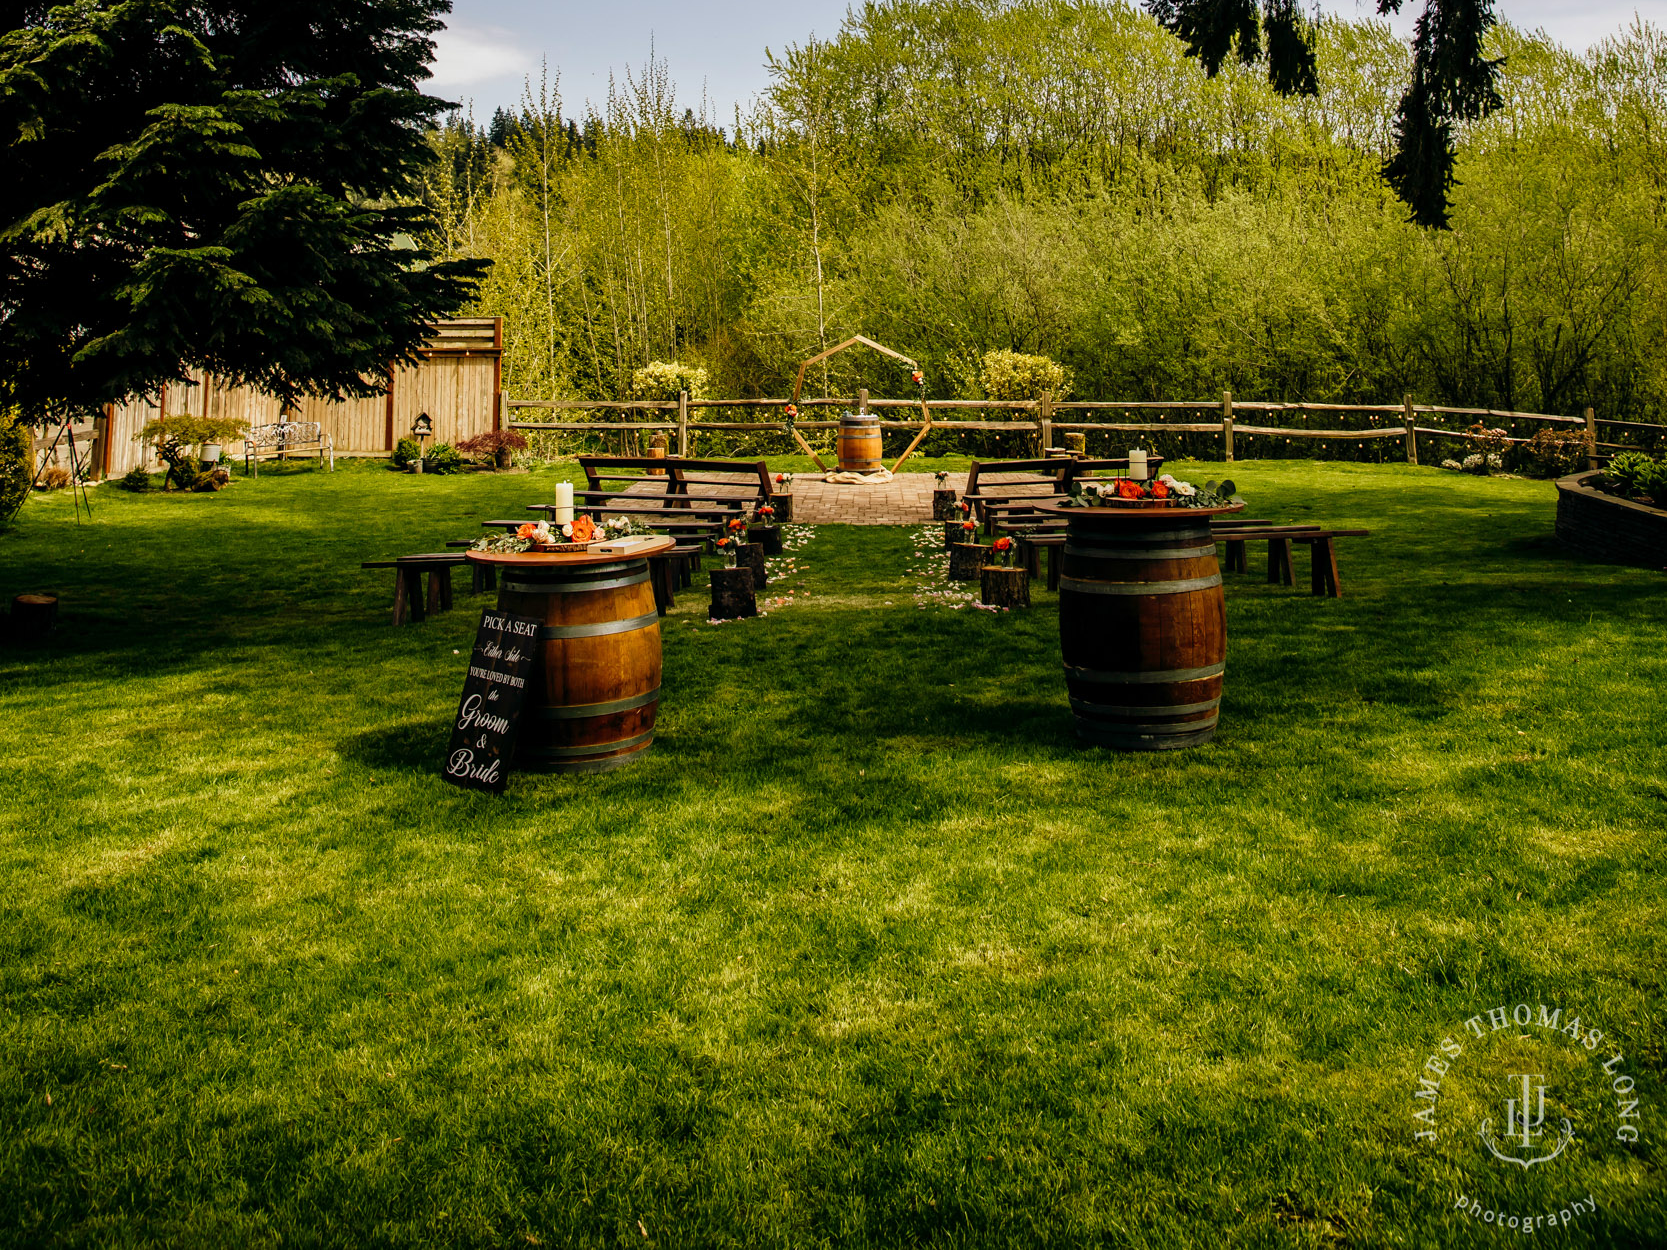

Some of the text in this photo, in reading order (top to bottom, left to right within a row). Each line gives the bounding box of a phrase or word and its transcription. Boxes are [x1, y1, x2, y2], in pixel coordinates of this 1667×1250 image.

[483, 616, 537, 637] PICK A SEAT
[483, 640, 521, 663] Either Side
[470, 666, 525, 689] YOU'RE LOVED BY BOTH
[487, 689, 499, 701] the
[458, 693, 509, 735] Groom
[476, 733, 487, 749] &
[446, 748, 500, 784] Bride
